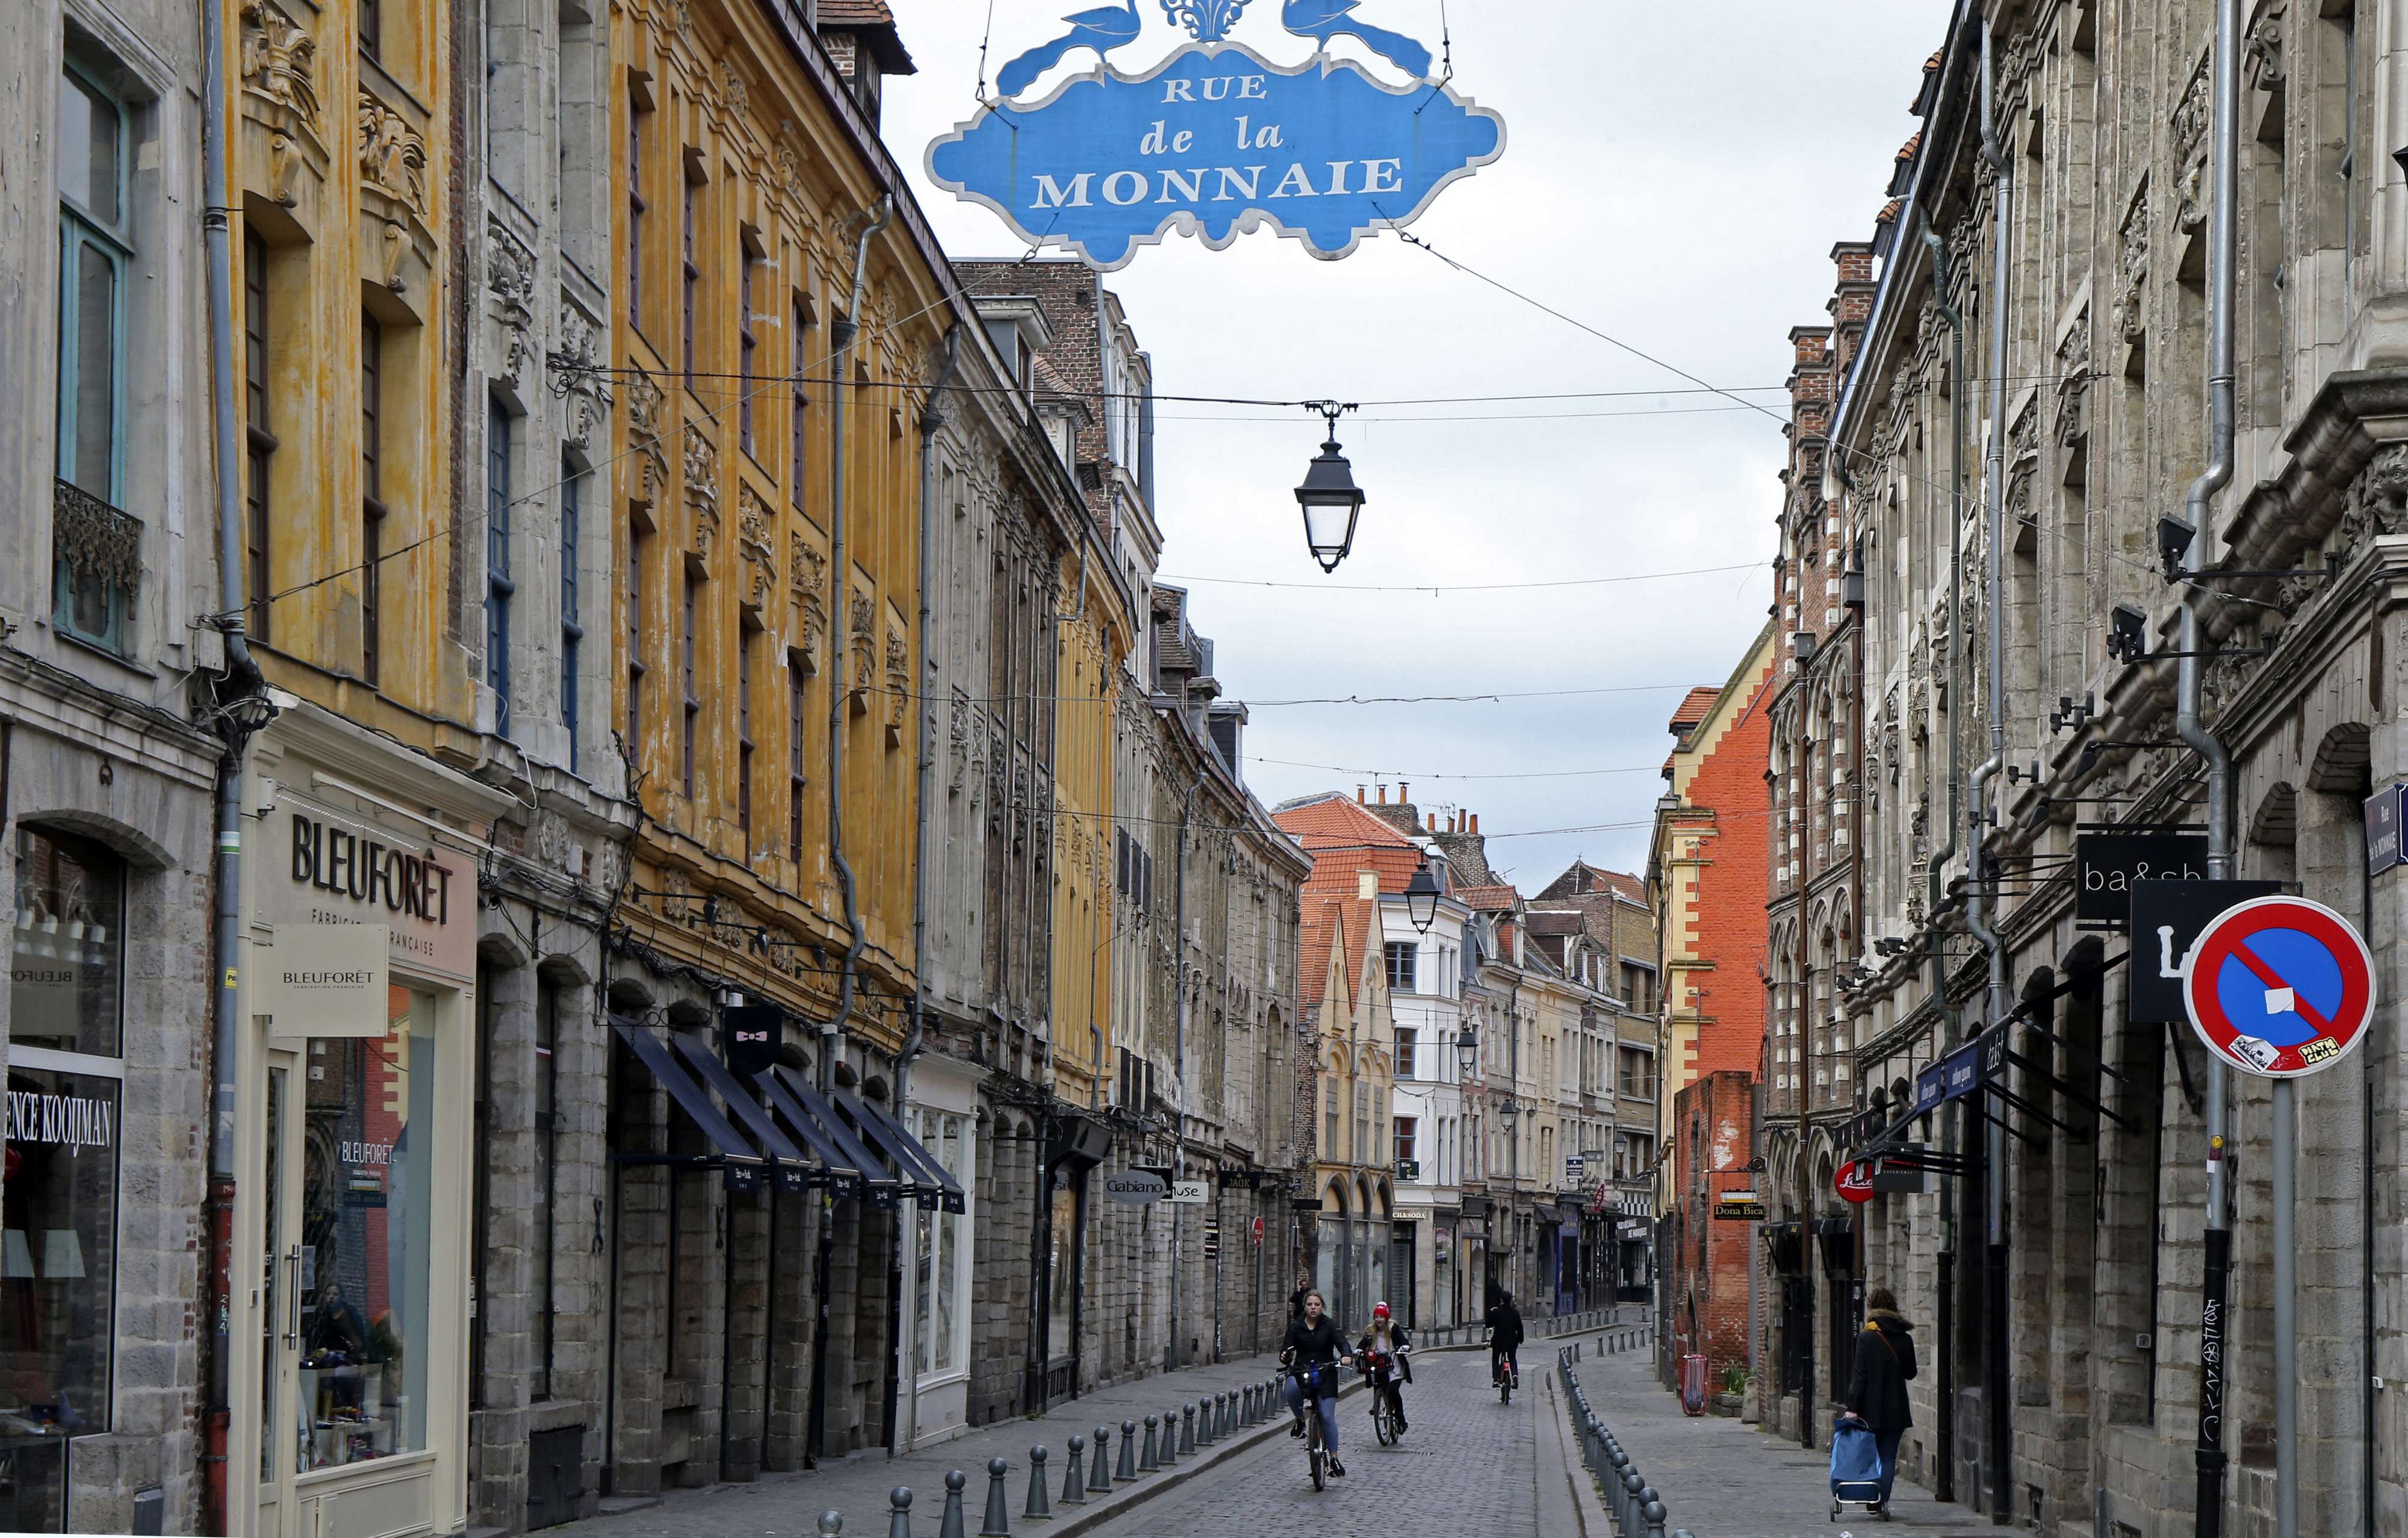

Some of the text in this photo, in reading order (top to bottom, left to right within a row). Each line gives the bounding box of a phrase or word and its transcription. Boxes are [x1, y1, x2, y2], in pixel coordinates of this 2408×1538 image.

[1161, 75, 1267, 103] RUE
[1140, 115, 1283, 155] de la
[1029, 158, 1402, 208] MONNAIE
[293, 814, 453, 925] BLEUFORÊT
[390, 931, 433, 956] RANÇAISE
[284, 970, 374, 983] BLEUFORÊT
[42, 1095, 111, 1157] KOOIJMAN
[342, 1137, 394, 1165] BLEUFORÊT
[1106, 1180, 1163, 1194] Gabiano
[1715, 1206, 1763, 1215] Dona Bica
